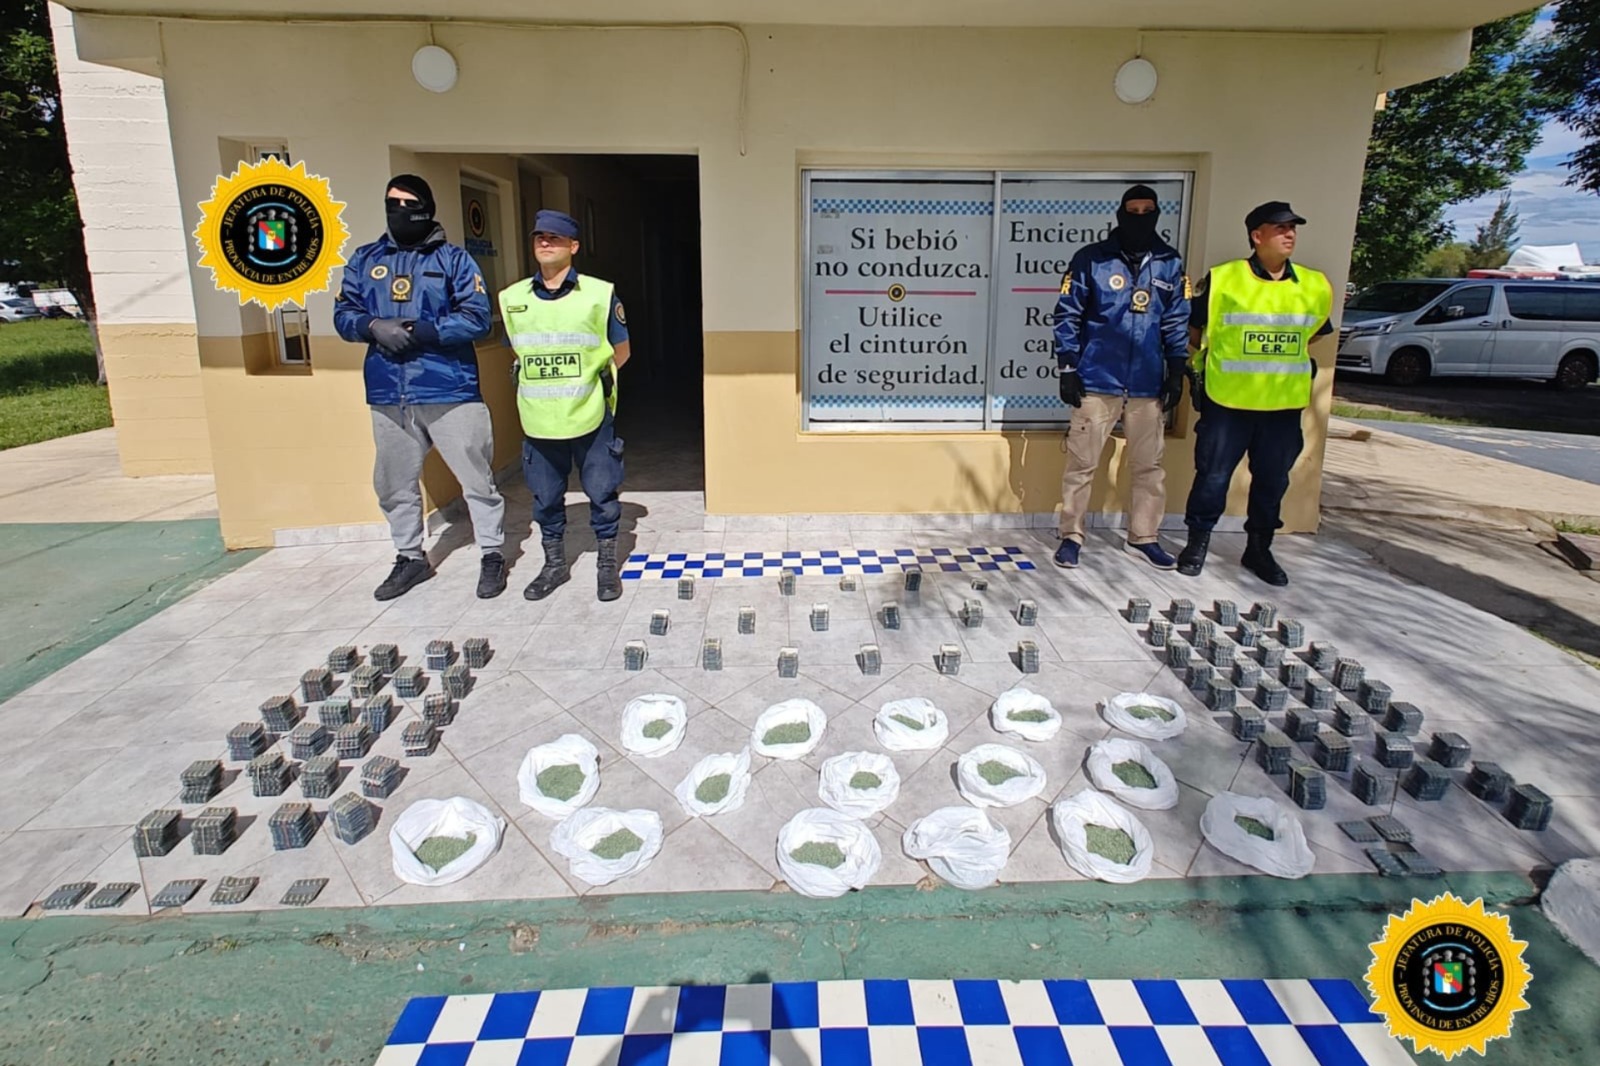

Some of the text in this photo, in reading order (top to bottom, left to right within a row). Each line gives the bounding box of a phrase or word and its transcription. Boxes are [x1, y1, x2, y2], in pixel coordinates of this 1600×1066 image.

[851, 227, 958, 250] Si bebió
[815, 256, 989, 278] no conduzca.
[1015, 253, 1072, 274] luce
[858, 306, 942, 328] Utilice
[830, 333, 968, 354] el cinturón
[1249, 334, 1298, 342] POLICIA
[1261, 345, 1285, 353] E.R.
[527, 356, 576, 366] POLICIA
[1000, 360, 1028, 379] de
[540, 368, 563, 377] E.R.
[818, 363, 985, 391] de seguridad.
